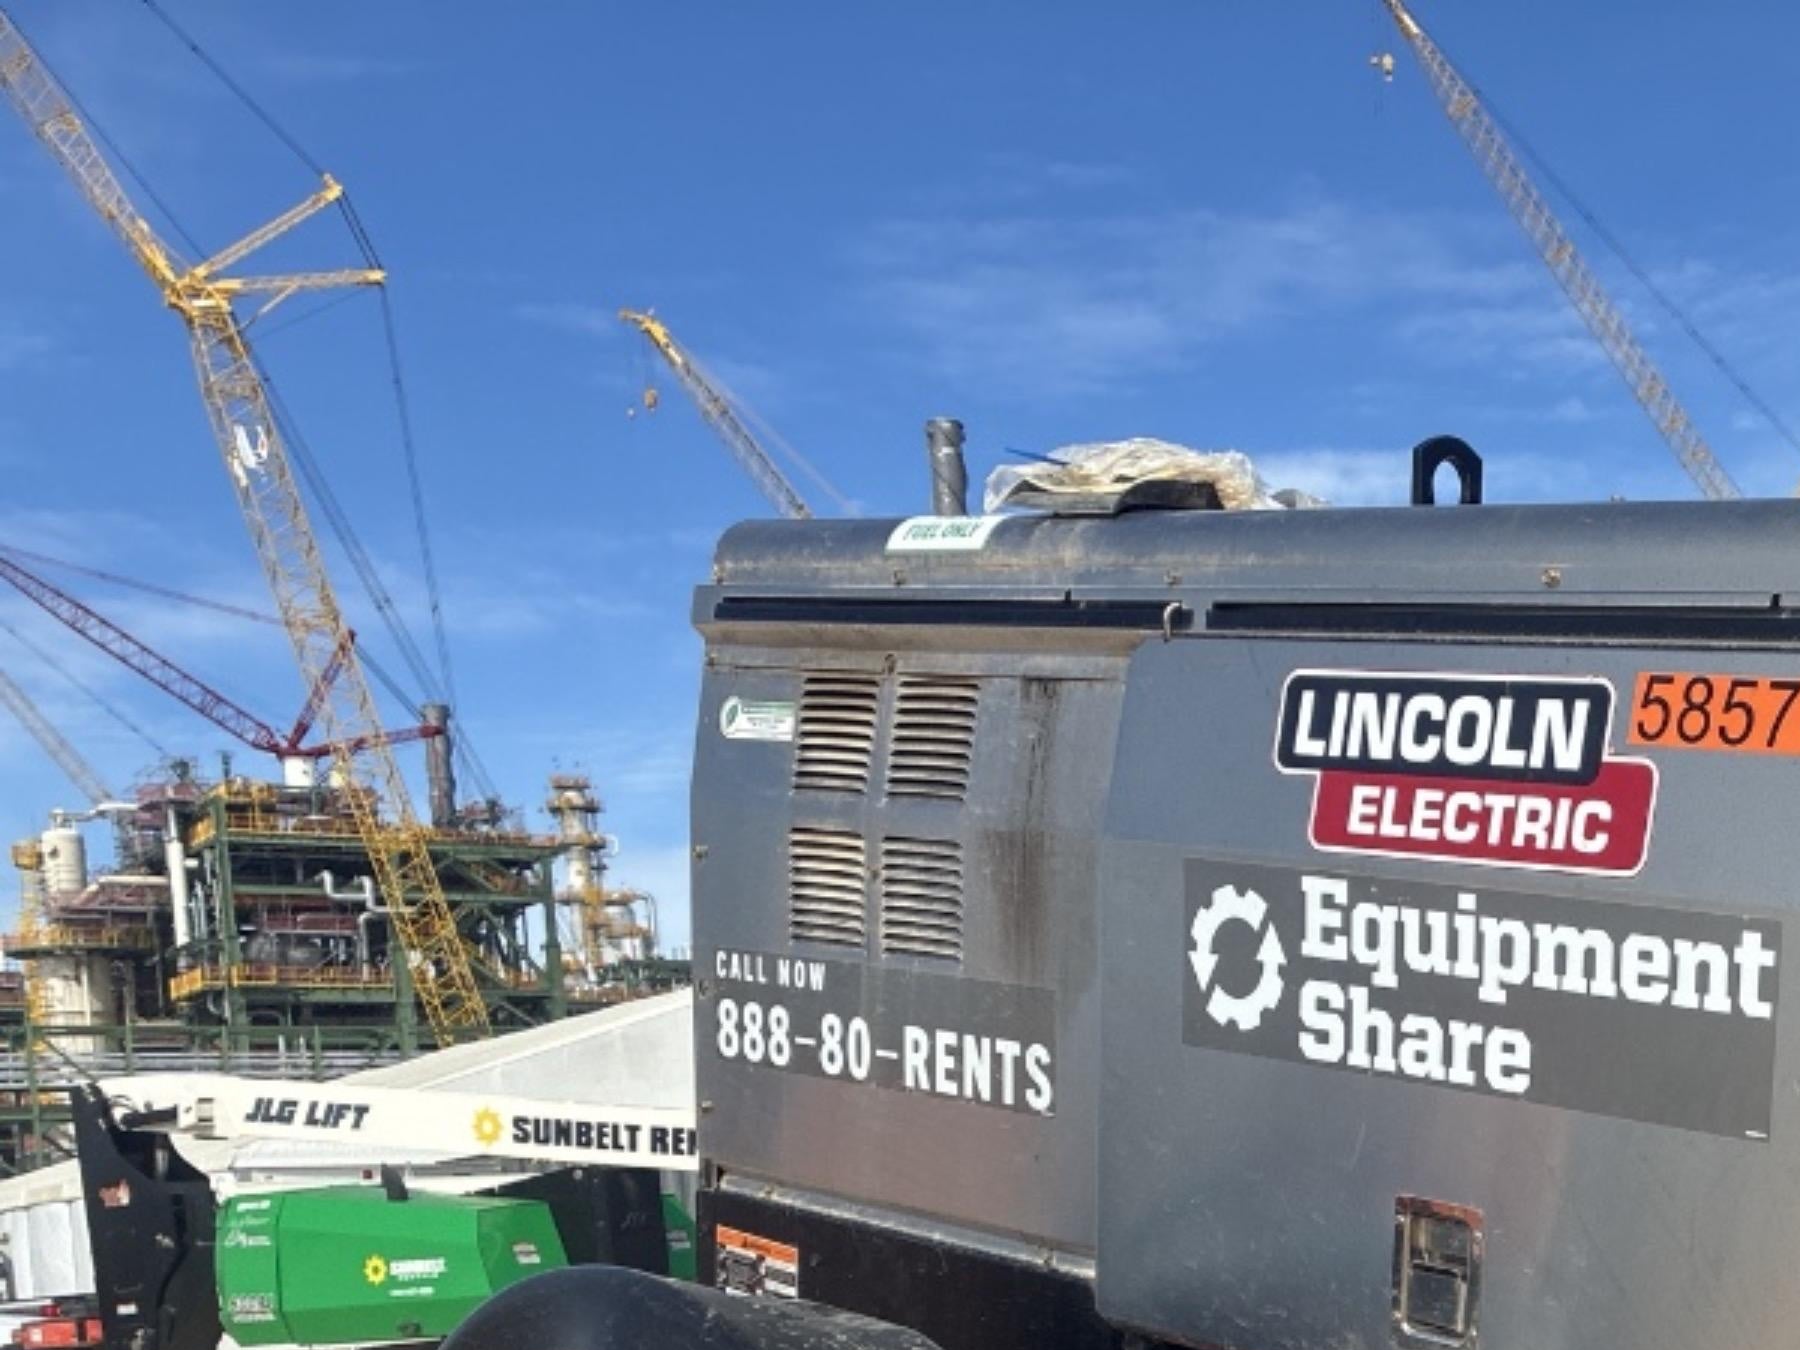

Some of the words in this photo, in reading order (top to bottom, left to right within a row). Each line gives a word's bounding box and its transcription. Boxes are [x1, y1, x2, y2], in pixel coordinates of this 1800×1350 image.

[1293, 688, 1591, 771] LINCOLN
[1347, 785, 1612, 854] ELECTRIC
[716, 951, 767, 985] CALL
[777, 961, 826, 991] NOW
[1300, 876, 1776, 1020] Equipment
[717, 998, 1053, 1112] 888-80-RENTS
[1298, 980, 1533, 1095] Share
[245, 1097, 299, 1123] JLG
[304, 1101, 369, 1130] LIFT
[512, 1116, 641, 1151] SUNBELT
